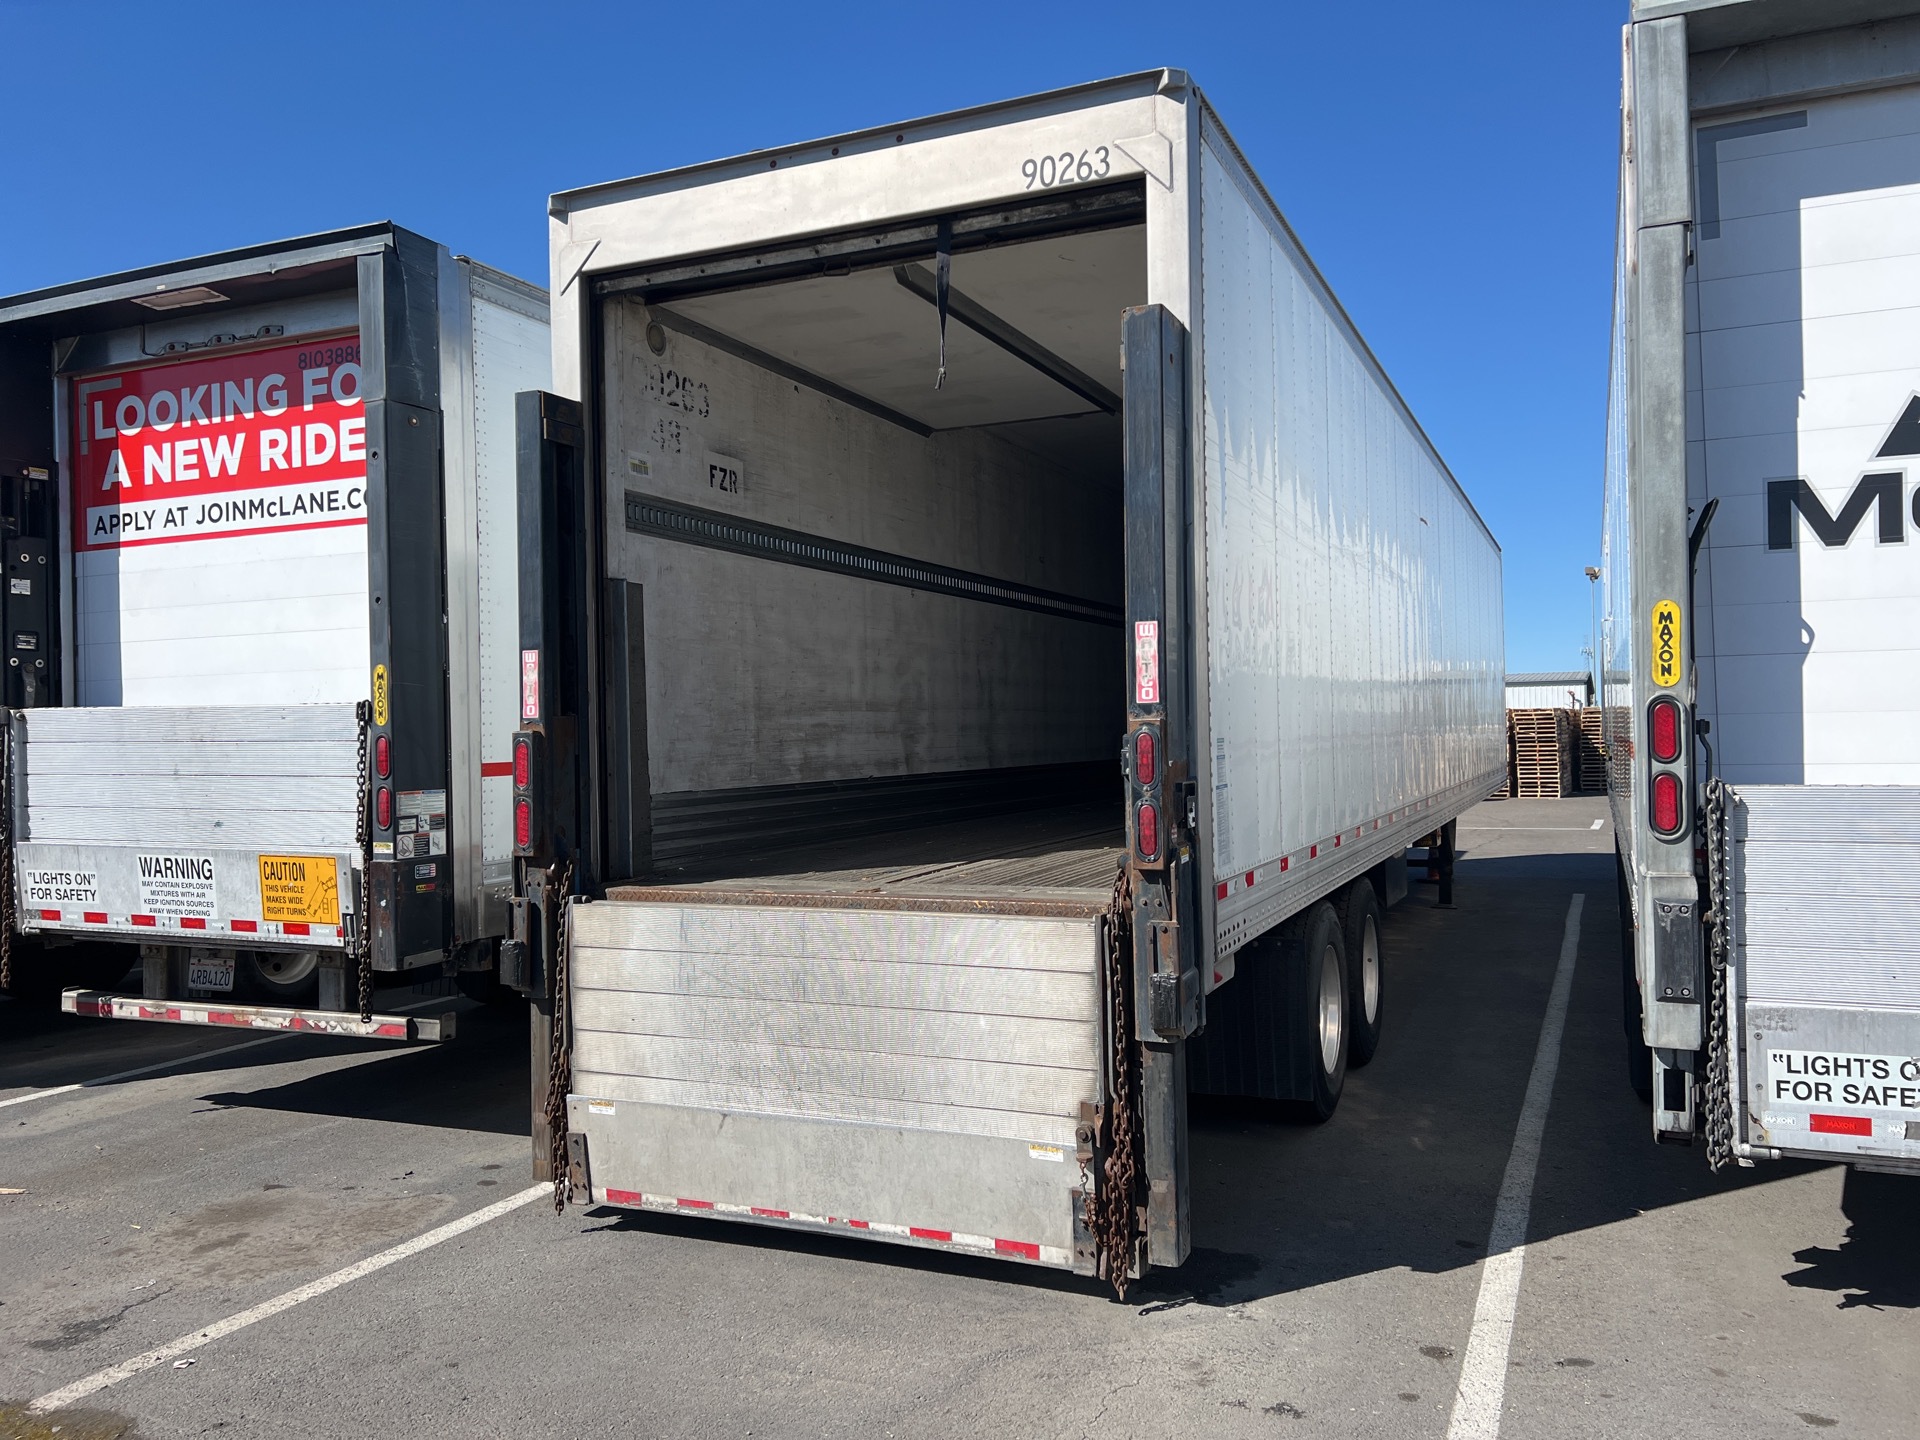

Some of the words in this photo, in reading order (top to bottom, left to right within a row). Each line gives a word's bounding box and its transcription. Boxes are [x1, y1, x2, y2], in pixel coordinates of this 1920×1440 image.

[1021, 145, 1111, 190] 90263
[93, 373, 288, 440] LOOKING
[101, 448, 133, 491] A
[143, 432, 247, 486] NEW
[259, 416, 366, 472] RIDE
[709, 463, 738, 494] FZR
[93, 509, 157, 536] APPLY
[163, 506, 189, 528] AT
[196, 487, 367, 526] JOINMcLANE.C
[1764, 469, 1920, 552] M
[1658, 611, 1673, 677] MAXON
[376, 672, 385, 719] MAXON
[138, 857, 213, 880] WARNING
[263, 861, 306, 882] CAUTION
[30, 886, 53, 900] FOR
[54, 888, 97, 902] SAFETY
[141, 880, 154, 888] MAY
[154, 881, 180, 889] CONTAIN
[181, 882, 214, 891] EXPLOSIVE
[150, 889, 180, 898] MIXTURES
[180, 891, 195, 899] WITH
[265, 884, 279, 893] THIS
[279, 885, 305, 894] VEHICLE
[159, 898, 185, 907] IGNITION
[185, 900, 215, 909] SOURCES
[265, 895, 287, 904] MAKES
[287, 896, 304, 905] WIDE
[148, 907, 165, 915] AWAY
[165, 908, 183, 916] WHEN
[183, 909, 211, 918] OPENING
[266, 906, 285, 915] RIGHT
[286, 907, 307, 917] TURNS
[191, 970, 230, 986] 4RB4120
[1775, 1079, 1833, 1103] FOR
[1825, 1120, 1857, 1131] MAXON
